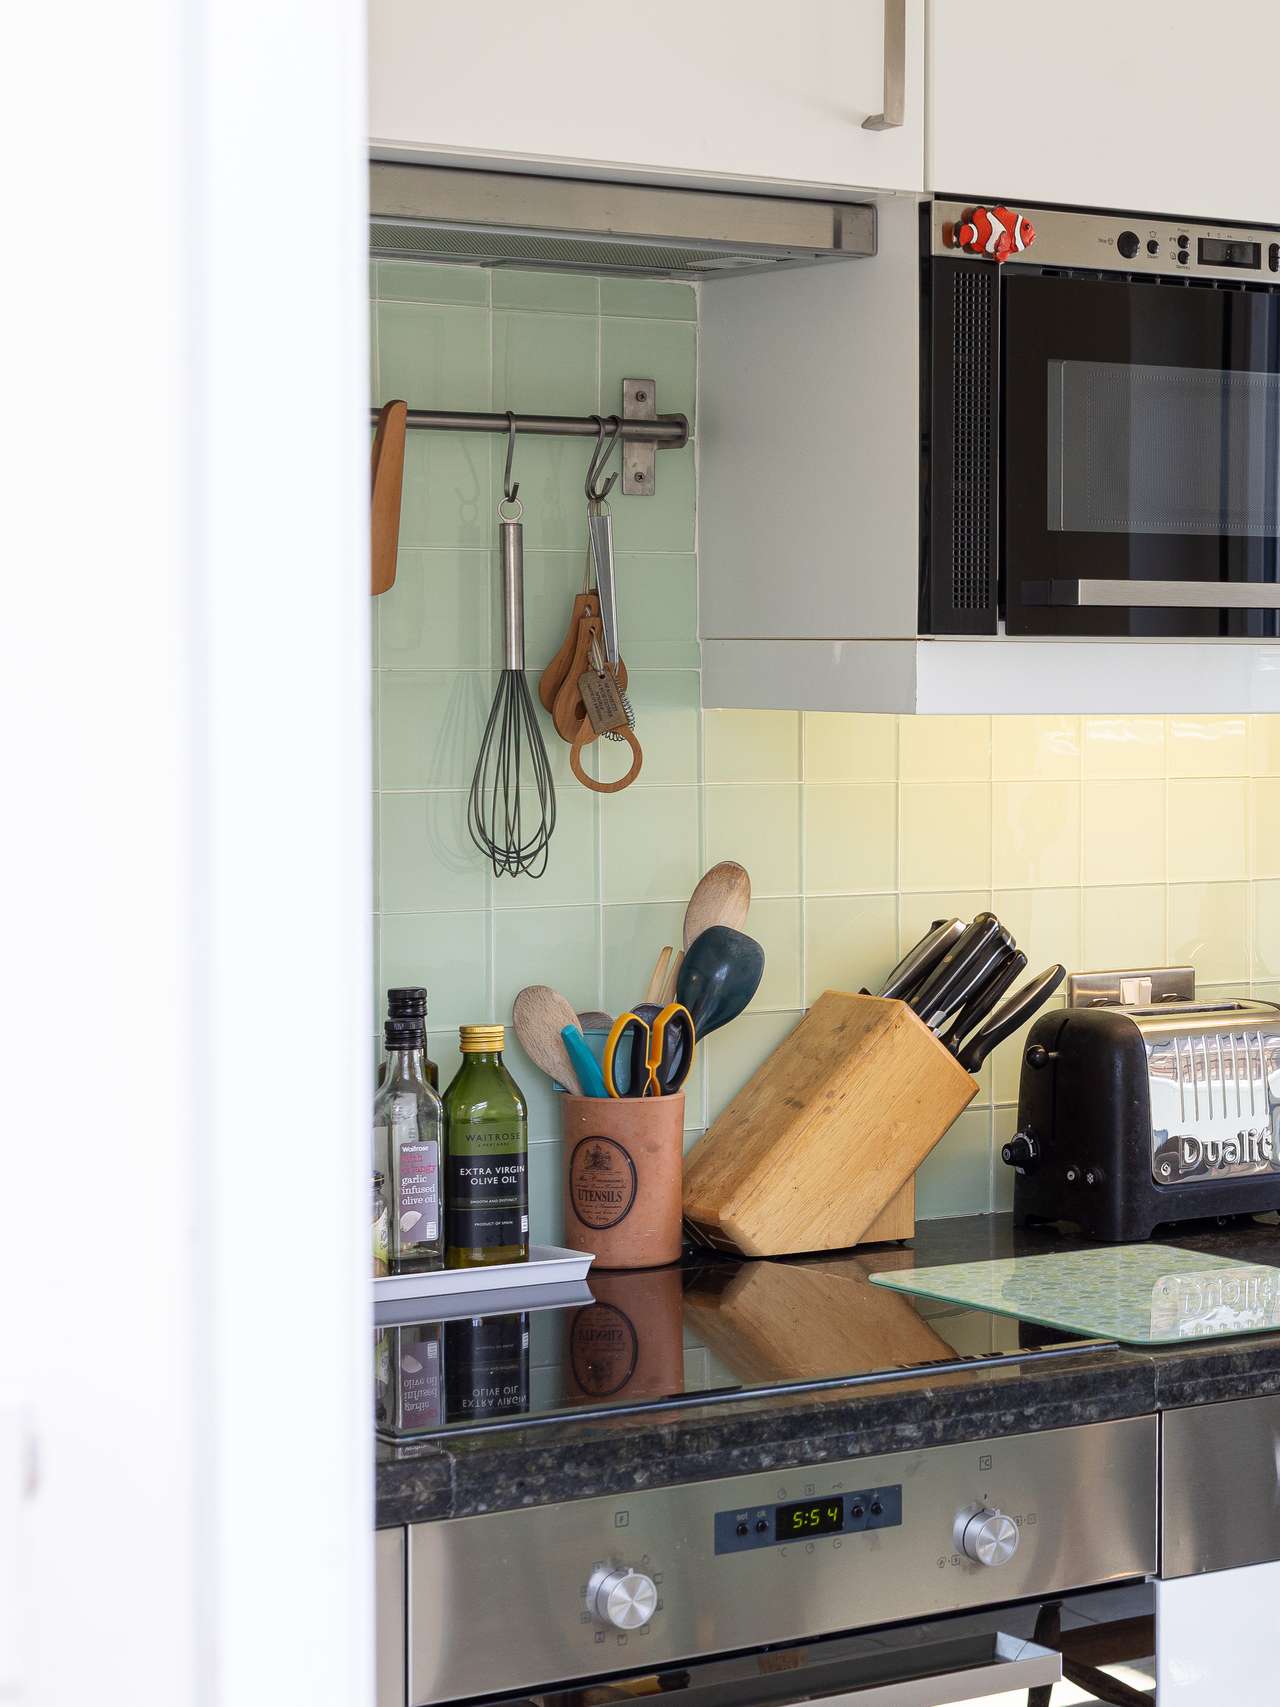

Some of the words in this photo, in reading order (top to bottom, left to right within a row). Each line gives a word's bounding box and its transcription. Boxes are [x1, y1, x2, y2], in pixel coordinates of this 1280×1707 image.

[465, 1132, 521, 1142] WAITROSE
[1178, 1127, 1273, 1170] Dualit
[460, 1167, 492, 1176] EXTRA
[495, 1165, 525, 1174] VIRGIN
[401, 1174, 428, 1187] garlic
[470, 1176, 499, 1186] OLIVE
[501, 1175, 518, 1184] OIL
[401, 1184, 435, 1195] infused
[577, 1189, 623, 1203] UTENSILS
[401, 1196, 424, 1206] olive
[424, 1193, 436, 1203] oil
[792, 1506, 839, 1529] 5:54
